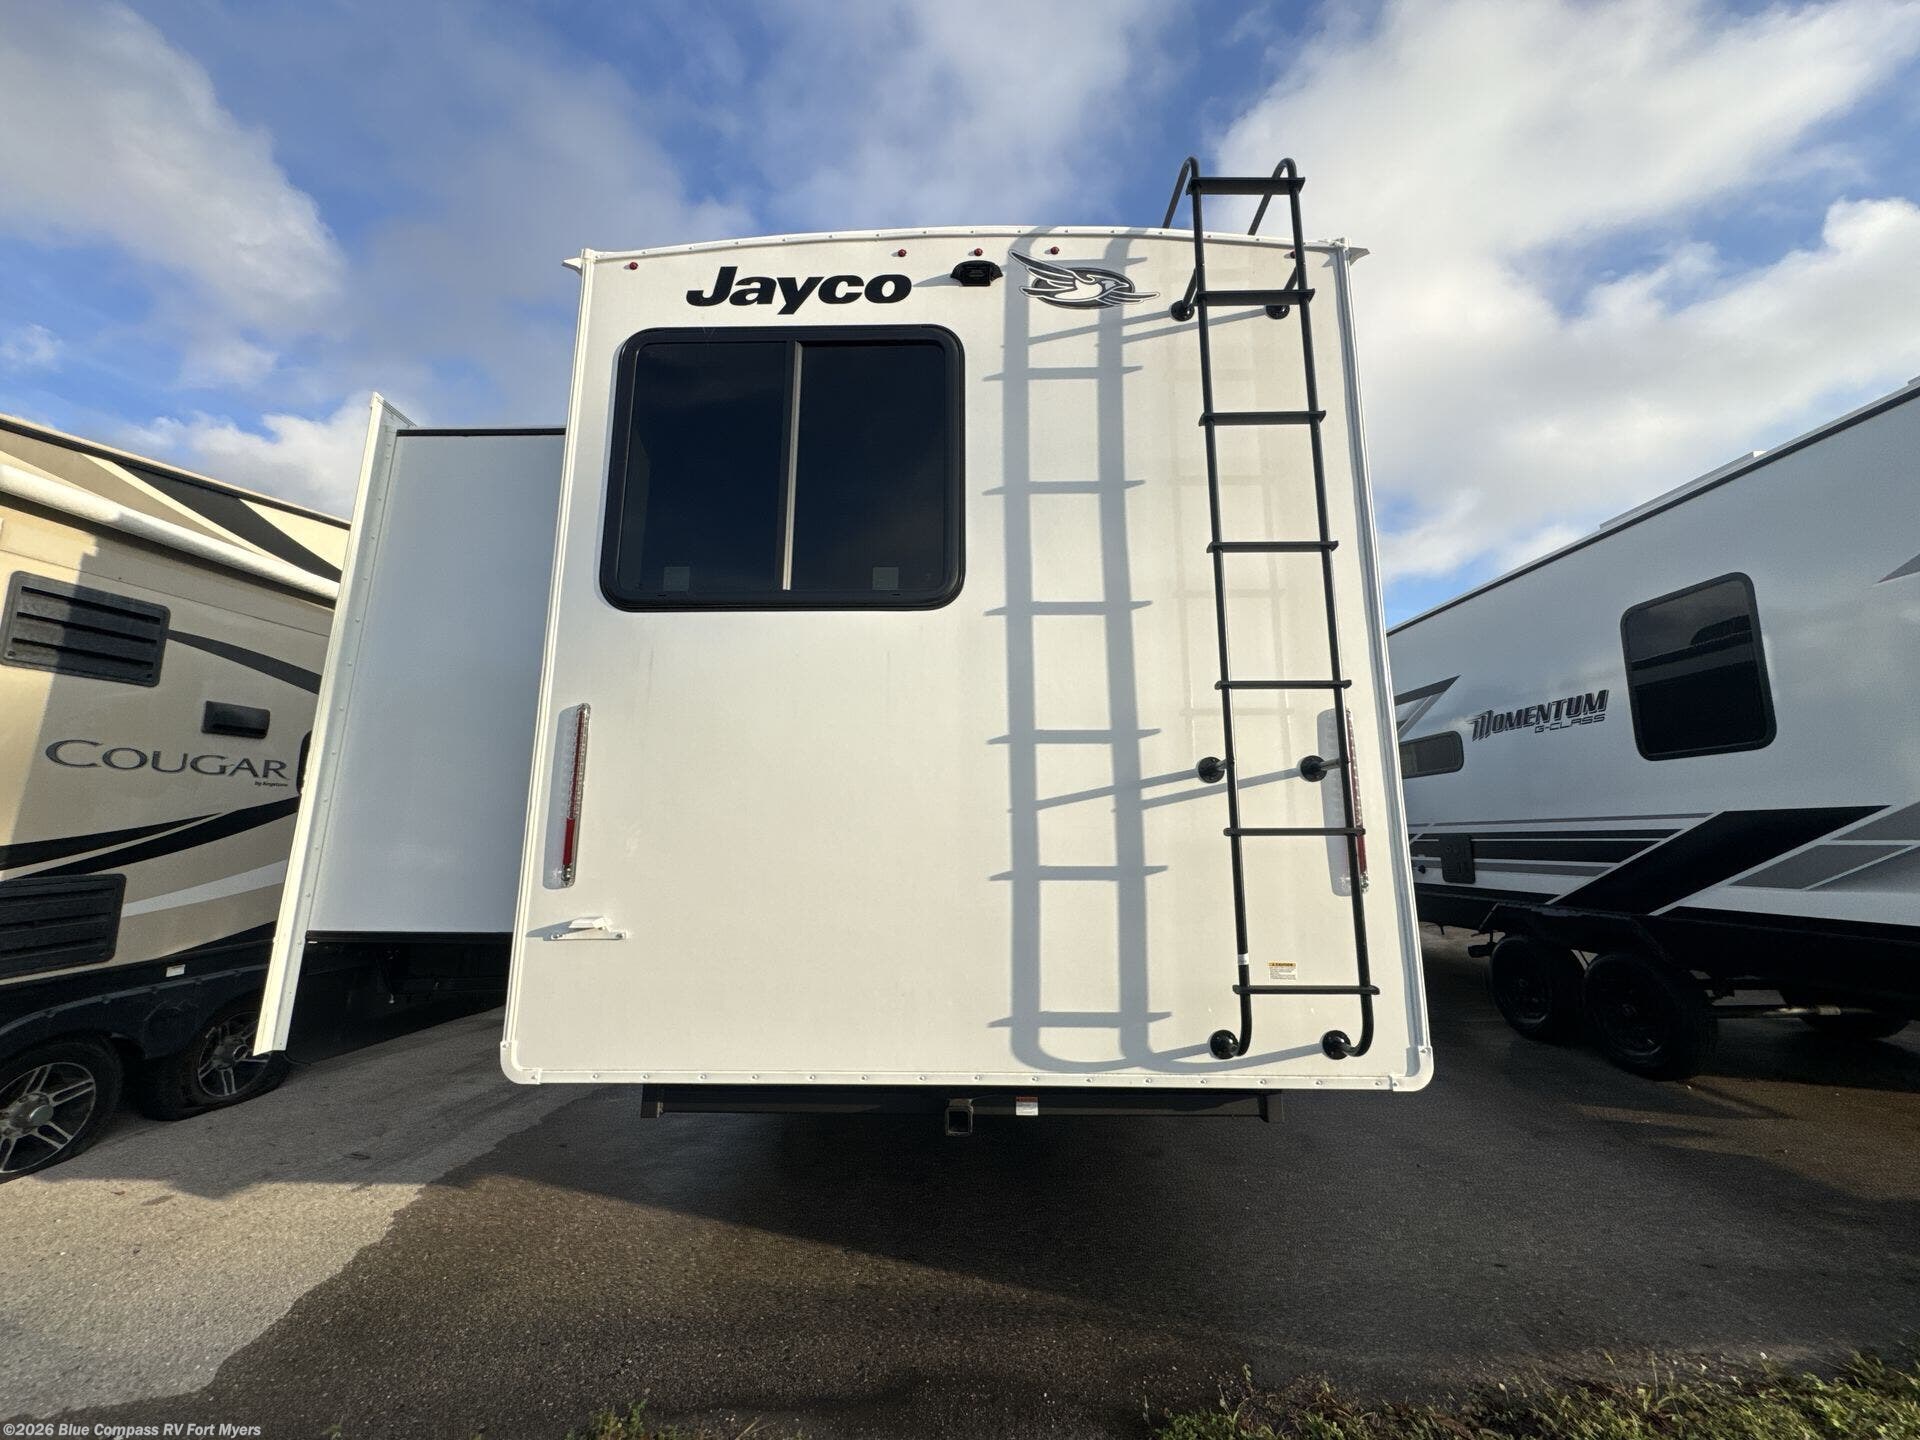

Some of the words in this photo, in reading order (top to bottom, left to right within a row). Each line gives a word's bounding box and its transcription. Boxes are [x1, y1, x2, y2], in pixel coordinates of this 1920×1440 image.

[686, 265, 912, 315] Jayco
[1468, 689, 1609, 741] MOMENTUM
[1534, 713, 1606, 733] G-CLASS
